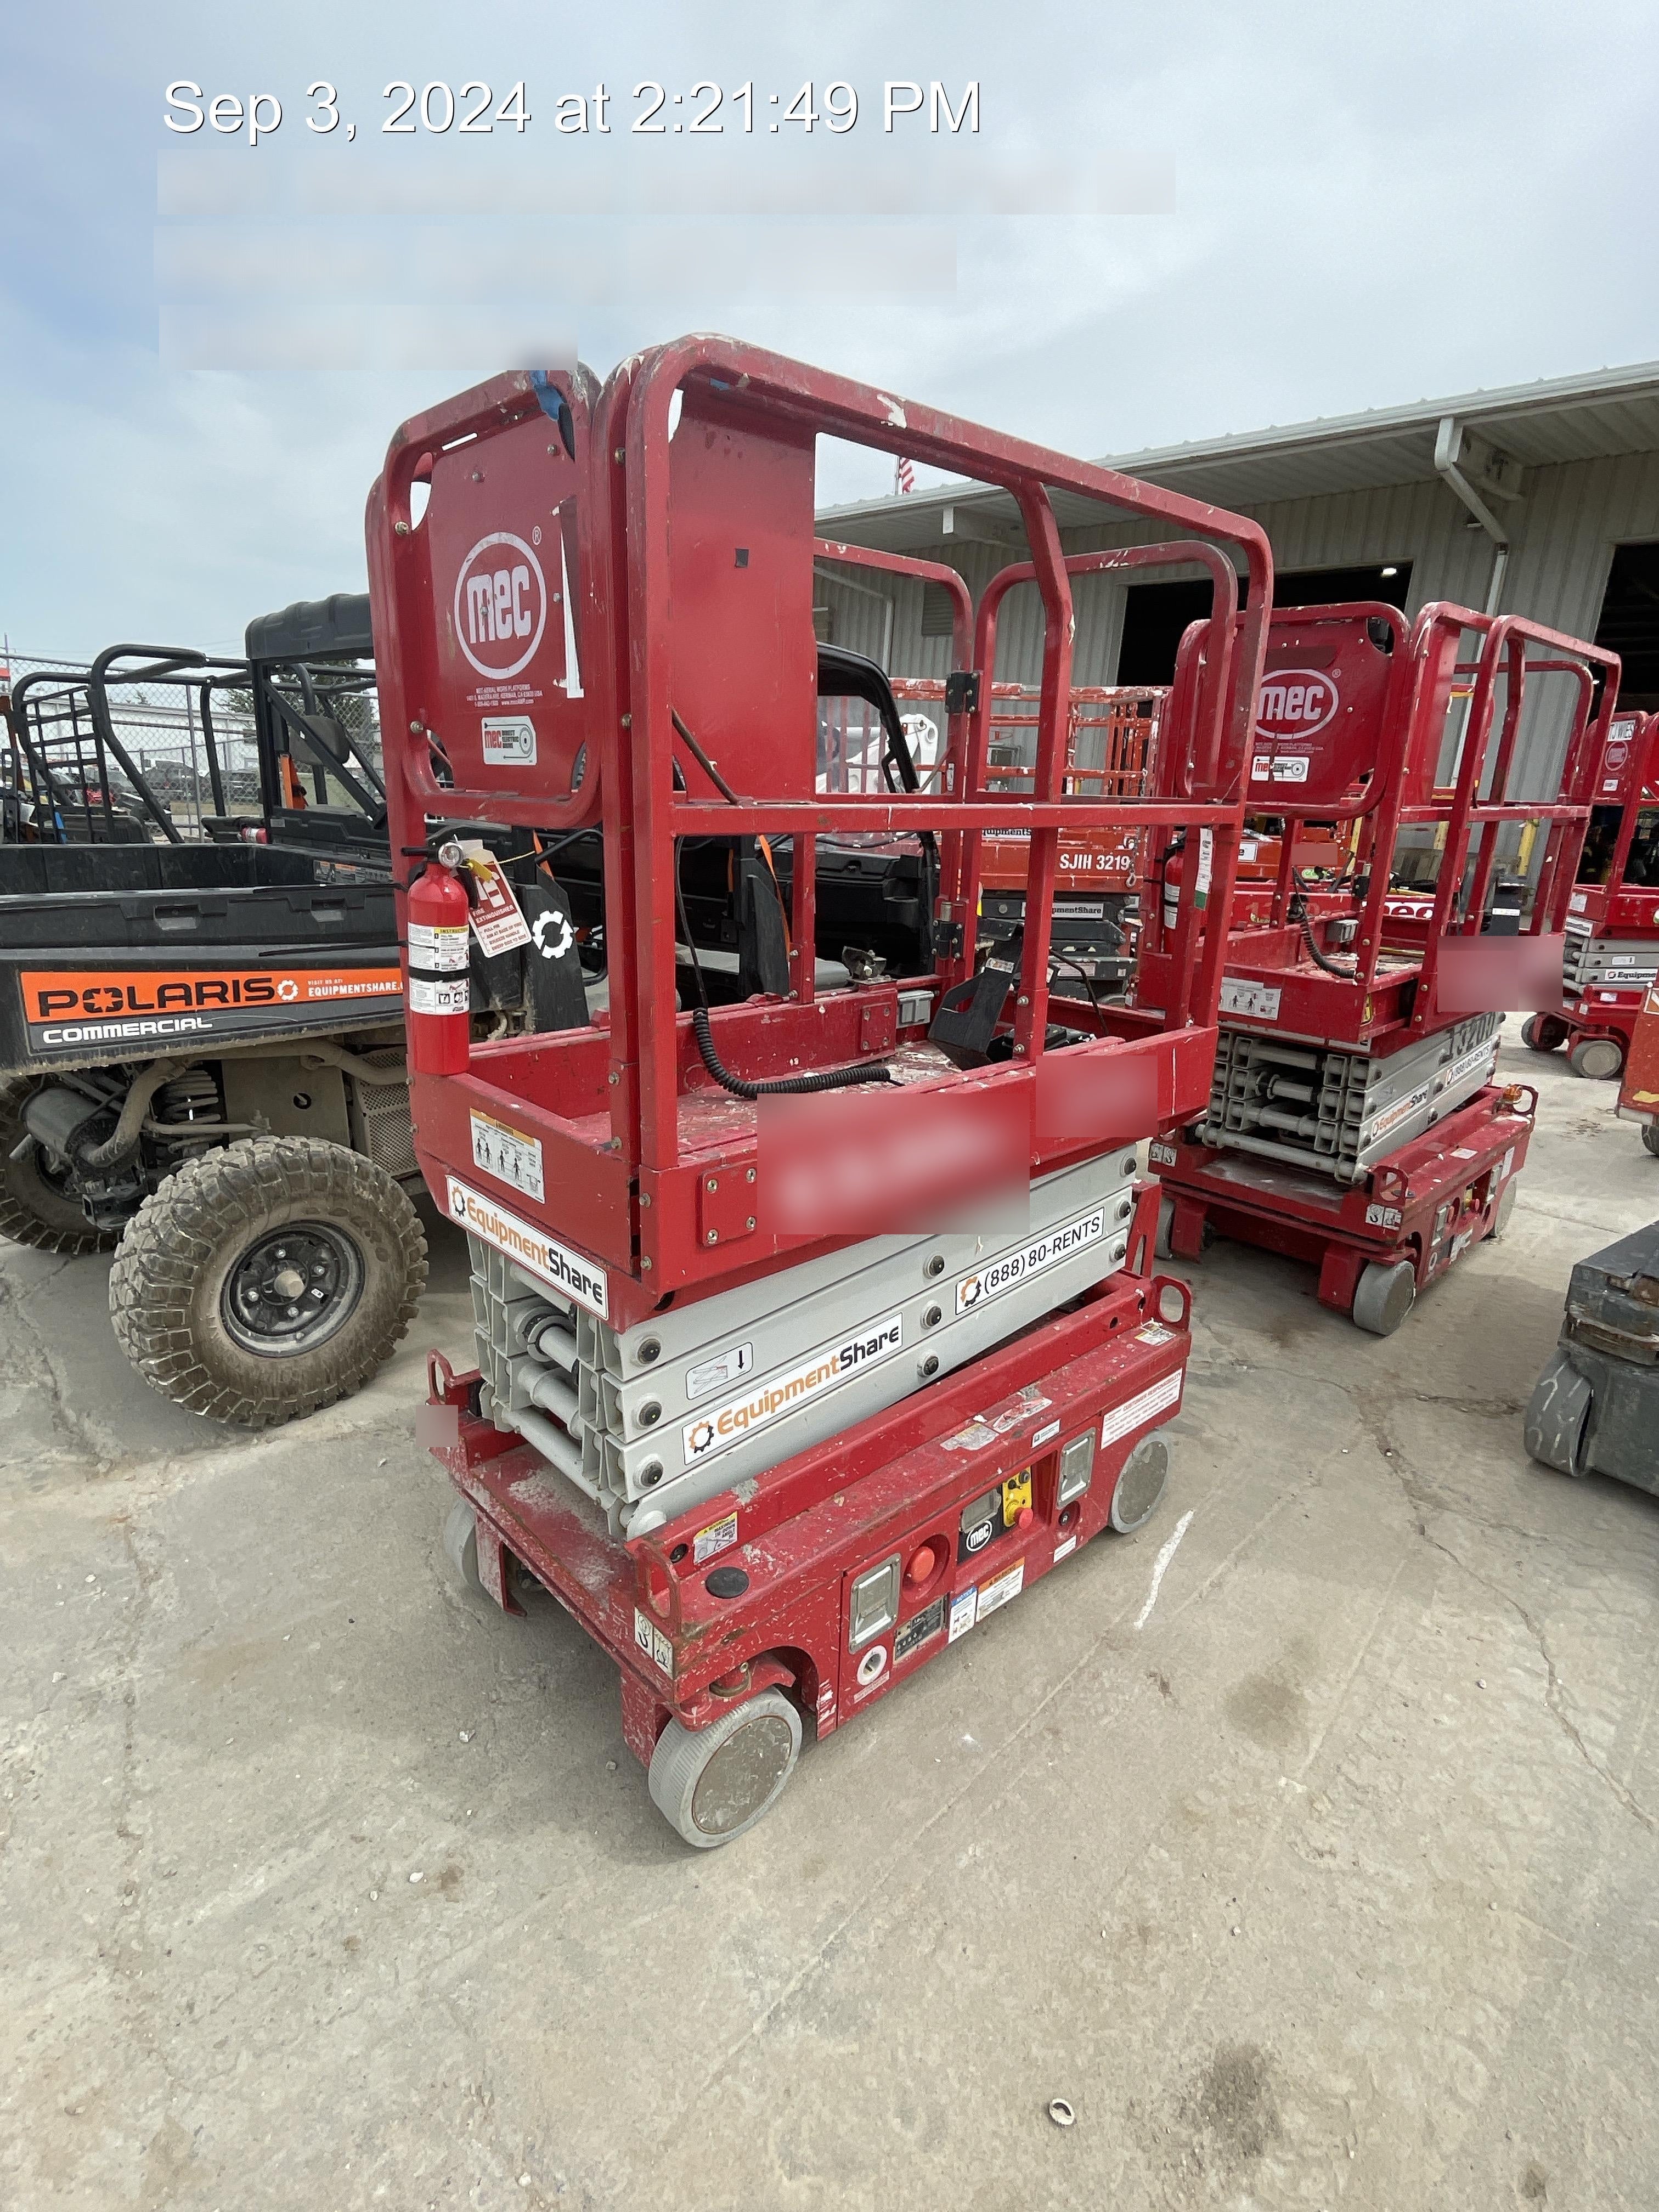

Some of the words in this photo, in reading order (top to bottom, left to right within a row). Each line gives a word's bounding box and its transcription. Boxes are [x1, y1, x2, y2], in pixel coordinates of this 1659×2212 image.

[1096, 855, 1130, 871] 3219
[37, 977, 275, 1018] POLARIS
[43, 1017, 213, 1045] COMMERCIAL
[466, 1197, 603, 1306] EquipmentShare
[984, 1259, 1025, 1295] (888)
[1028, 1216, 1101, 1268] 80-RENTS
[717, 1323, 900, 1436] EquipmentShare
